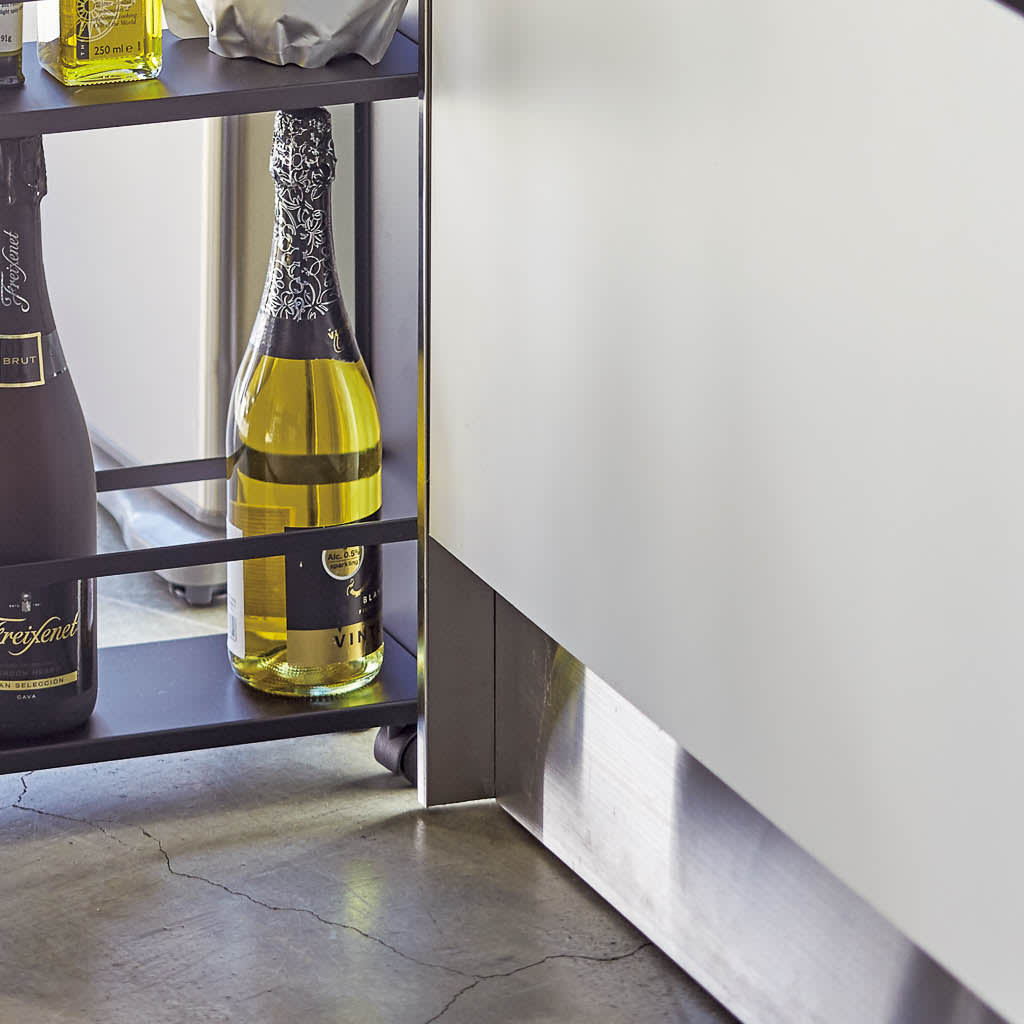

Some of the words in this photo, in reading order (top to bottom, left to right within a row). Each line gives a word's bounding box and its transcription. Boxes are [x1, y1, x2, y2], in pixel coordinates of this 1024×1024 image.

[94, 45, 110, 56] 250
[112, 43, 123, 53] ml
[1, 230, 30, 313] Freixenet
[3, 355, 37, 365] BRUT
